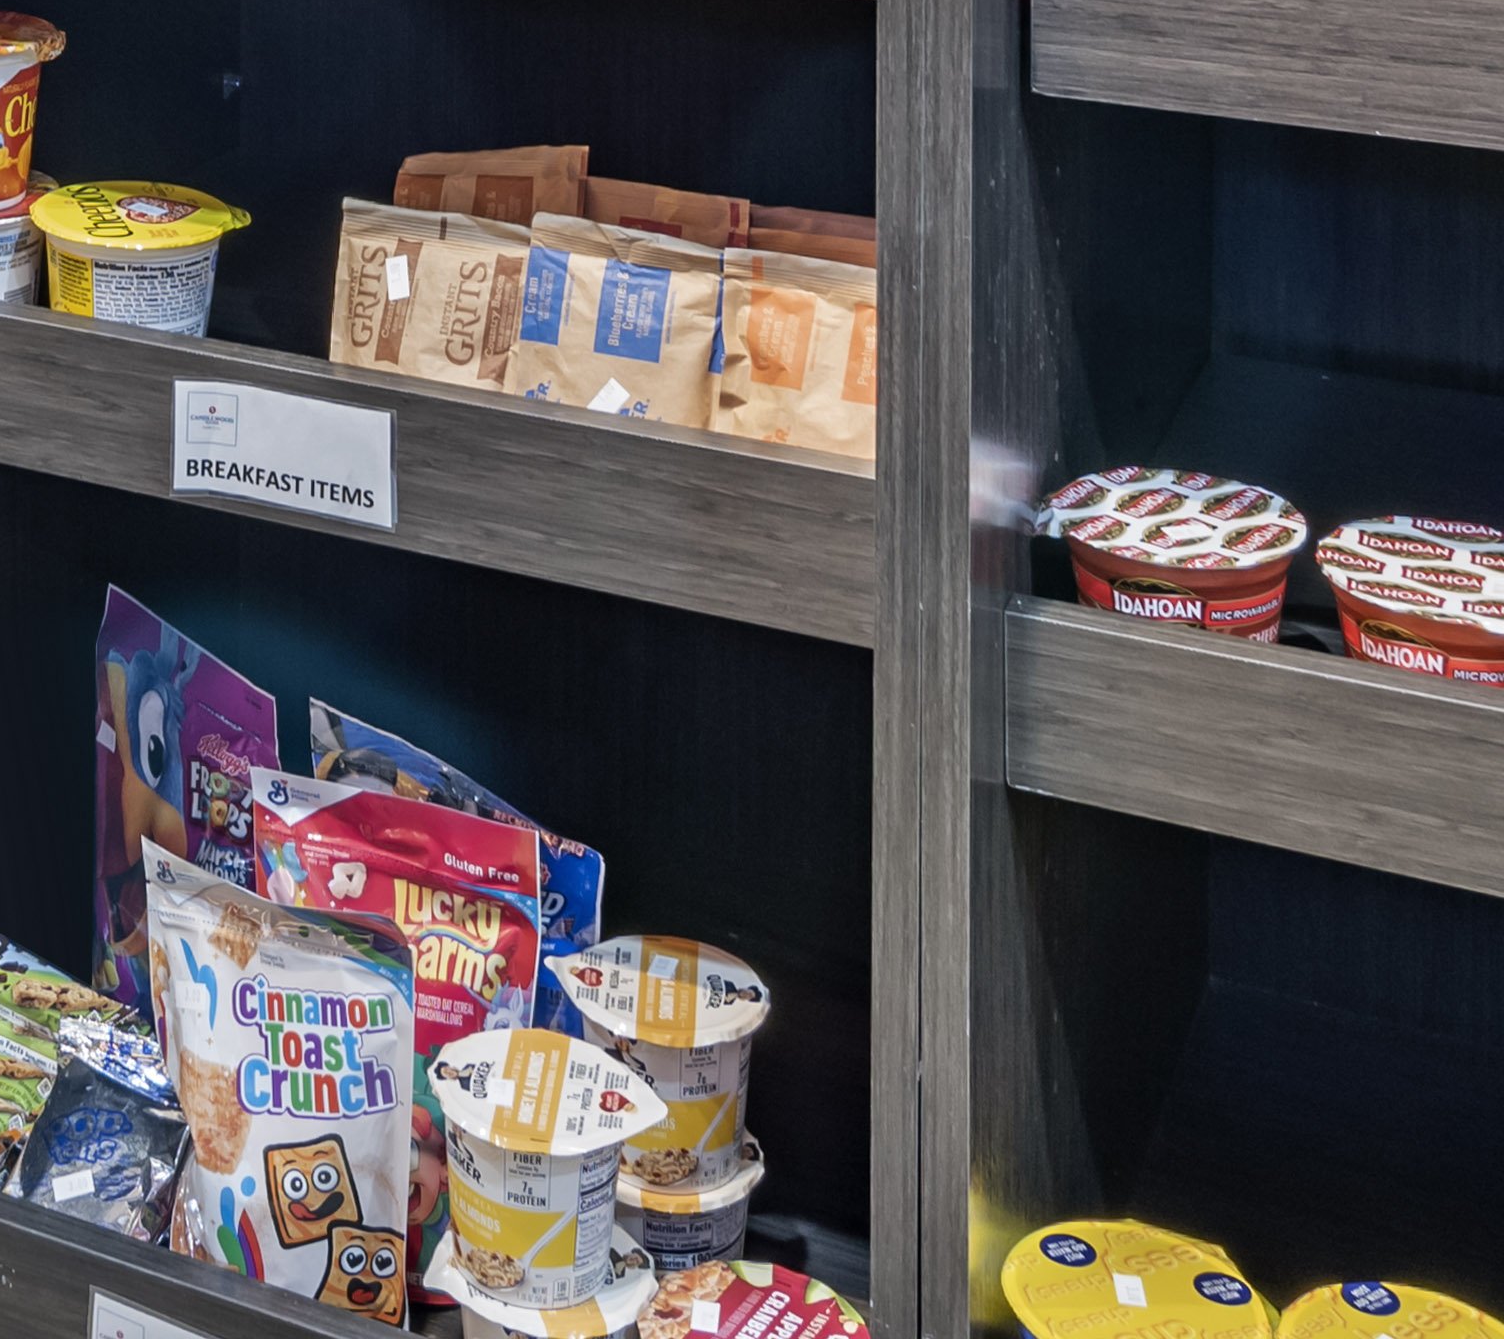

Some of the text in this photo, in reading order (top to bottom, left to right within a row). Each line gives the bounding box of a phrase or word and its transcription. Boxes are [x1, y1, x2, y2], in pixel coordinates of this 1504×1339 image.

[353, 244, 389, 350] GRITS
[444, 260, 490, 366] GRITS
[607, 285, 628, 349] Blueberries
[185, 458, 375, 509] BREAKFAST ITEMS
[1361, 535, 1451, 560] IDAHOAN
[1416, 519, 1503, 540] IDAHOAN
[1113, 591, 1202, 620] IDAHOAN
[1351, 584, 1443, 607] IDAHOAN
[1360, 632, 1445, 675] IDAHOAN
[444, 852, 520, 884] Gluten Free
[393, 878, 502, 943] Lucky
[410, 940, 508, 1004] arms
[235, 978, 394, 1032] Cinnamon
[263, 1025, 365, 1070] Toast
[237, 1054, 398, 1119] Crunch
[473, 1060, 490, 1100] QUAKER
[682, 1084, 719, 1098] PROTEIN
[514, 1153, 542, 1166] FIBER
[508, 1193, 547, 1208] PROTEIN
[646, 1222, 688, 1236] Nutrition
